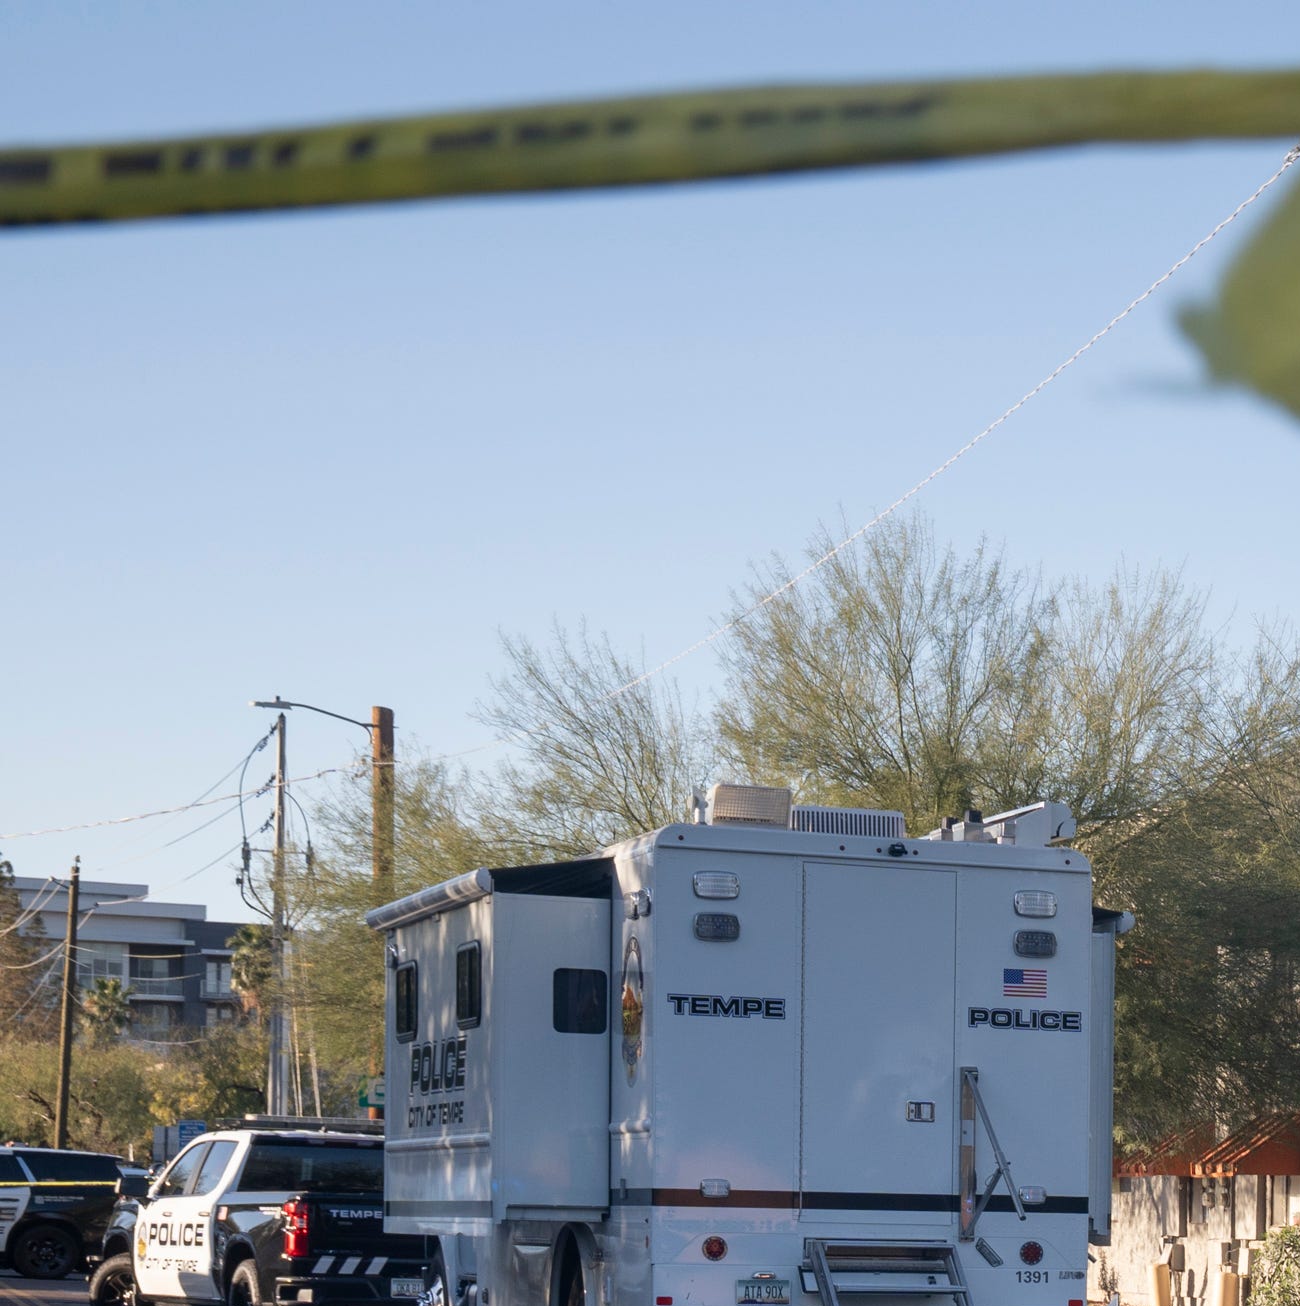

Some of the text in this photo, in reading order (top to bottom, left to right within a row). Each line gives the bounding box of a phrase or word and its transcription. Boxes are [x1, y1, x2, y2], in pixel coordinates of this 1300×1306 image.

[667, 993, 786, 1020] TEMPE
[968, 1008, 1082, 1032] POLICE
[409, 1036, 467, 1097] POLICE
[426, 1104, 437, 1127] OF
[328, 1209, 383, 1219] TEMPE
[149, 1223, 205, 1247] POLICE
[1015, 1271, 1050, 1284] 1391
[744, 1285, 762, 1299] ATA
